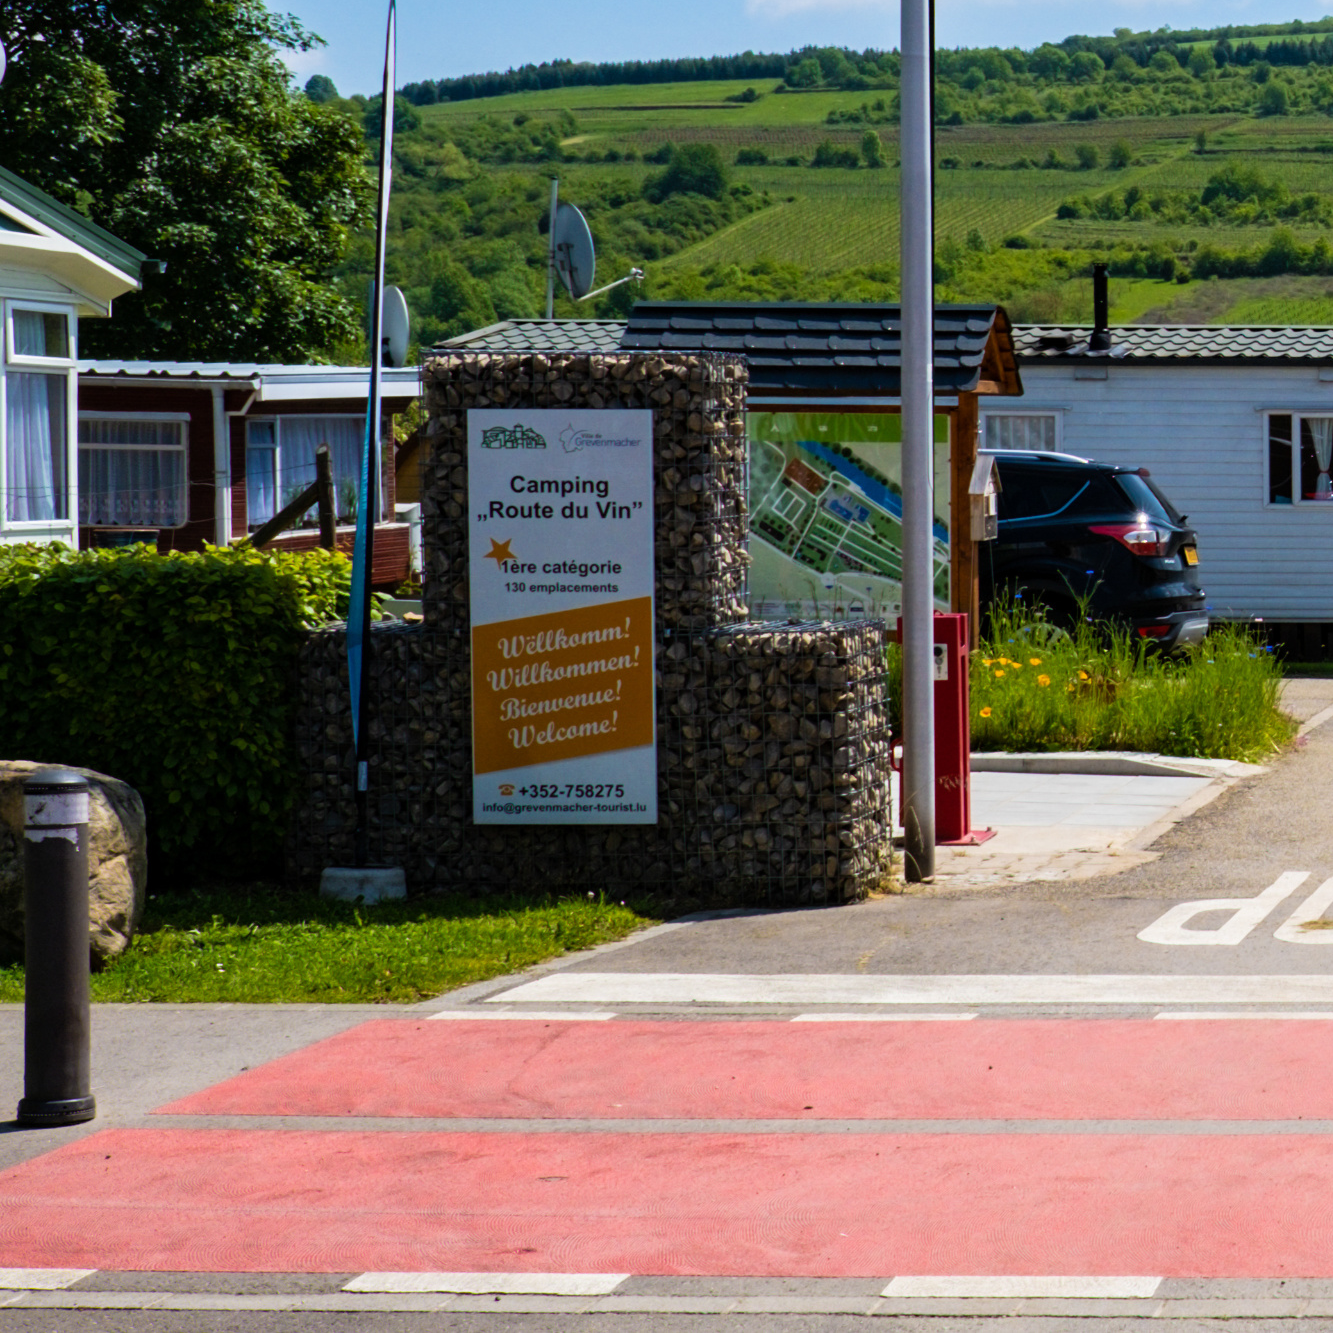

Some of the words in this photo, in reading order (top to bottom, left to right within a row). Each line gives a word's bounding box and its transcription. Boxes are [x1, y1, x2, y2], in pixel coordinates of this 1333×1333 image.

[575, 436, 643, 447] Grevenmacher
[510, 475, 609, 498] Camping
[561, 501, 588, 519] du
[501, 560, 537, 574] 1ère
[542, 560, 622, 577] catégorie
[505, 582, 526, 593] 130
[530, 582, 619, 594] emplacements
[498, 617, 630, 659] Wëllkomm!
[487, 645, 640, 692] Willkommen!
[500, 679, 622, 722] Bienvenue!
[508, 710, 618, 749] Welcome!
[519, 784, 624, 798] +352-758275
[482, 802, 647, 814] info@grevenmacher-tourist.lu
